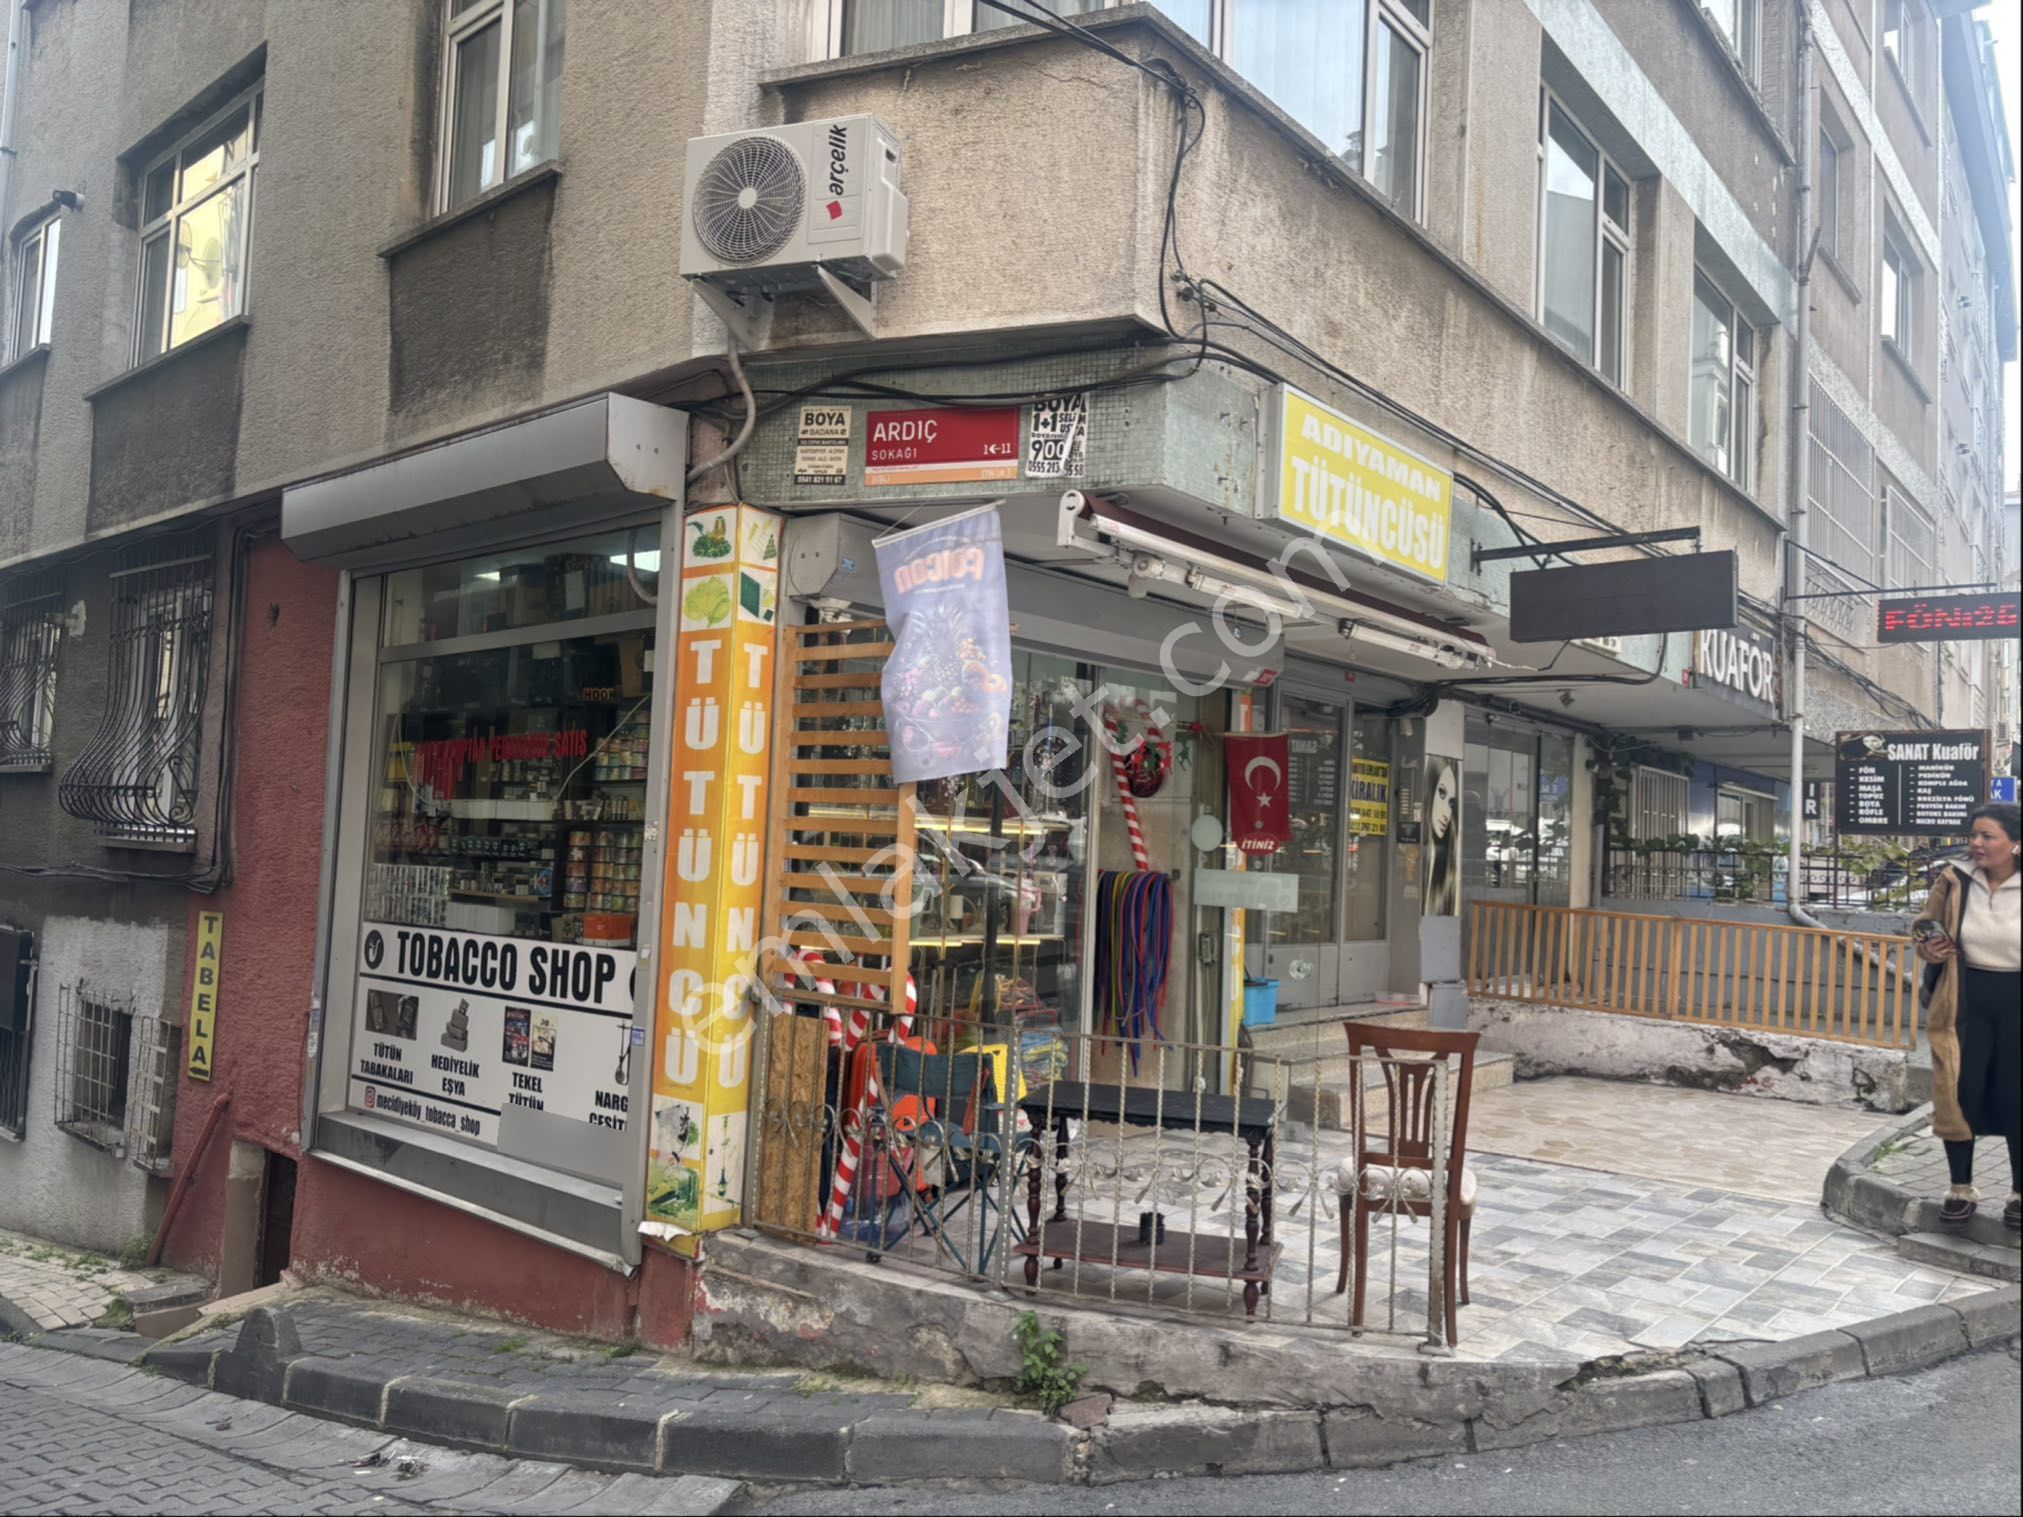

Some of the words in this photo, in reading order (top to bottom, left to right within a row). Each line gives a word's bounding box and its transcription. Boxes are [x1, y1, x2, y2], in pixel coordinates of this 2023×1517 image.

[829, 124, 847, 196] arçelik
[804, 412, 846, 426] BOYA
[1033, 412, 1058, 432] 1+1
[873, 420, 937, 443] ARDIÇ
[872, 448, 917, 461] SOKAĞI
[1302, 414, 1440, 502] ADIYAMAN
[1292, 455, 1444, 569] TÜTÜNCÜSÜ
[1701, 629, 1774, 702] KUAFÖR
[1887, 744, 1930, 761] SANAT
[1933, 743, 1979, 761] Kuaför
[1859, 775, 1885, 783] KESİM
[1859, 785, 1882, 793] MAŞA
[1859, 800, 1880, 808] BOYA
[1859, 807, 1884, 816] RÖFLE
[1241, 838, 1275, 850] İTİNİZ
[664, 640, 721, 1084] TÜTÜNCÜ
[719, 643, 769, 1088] TÜTÜNCÜ
[397, 931, 517, 991] TOBACCO
[528, 946, 616, 1004] SHOP
[192, 916, 218, 1065] TABELA
[373, 1042, 402, 1062] TÜTÜN
[360, 1059, 413, 1085] TABAKALARI
[431, 1054, 480, 1079] HEDİYELİK
[442, 1077, 466, 1097] EŞYA
[512, 1072, 543, 1093] TEKEL
